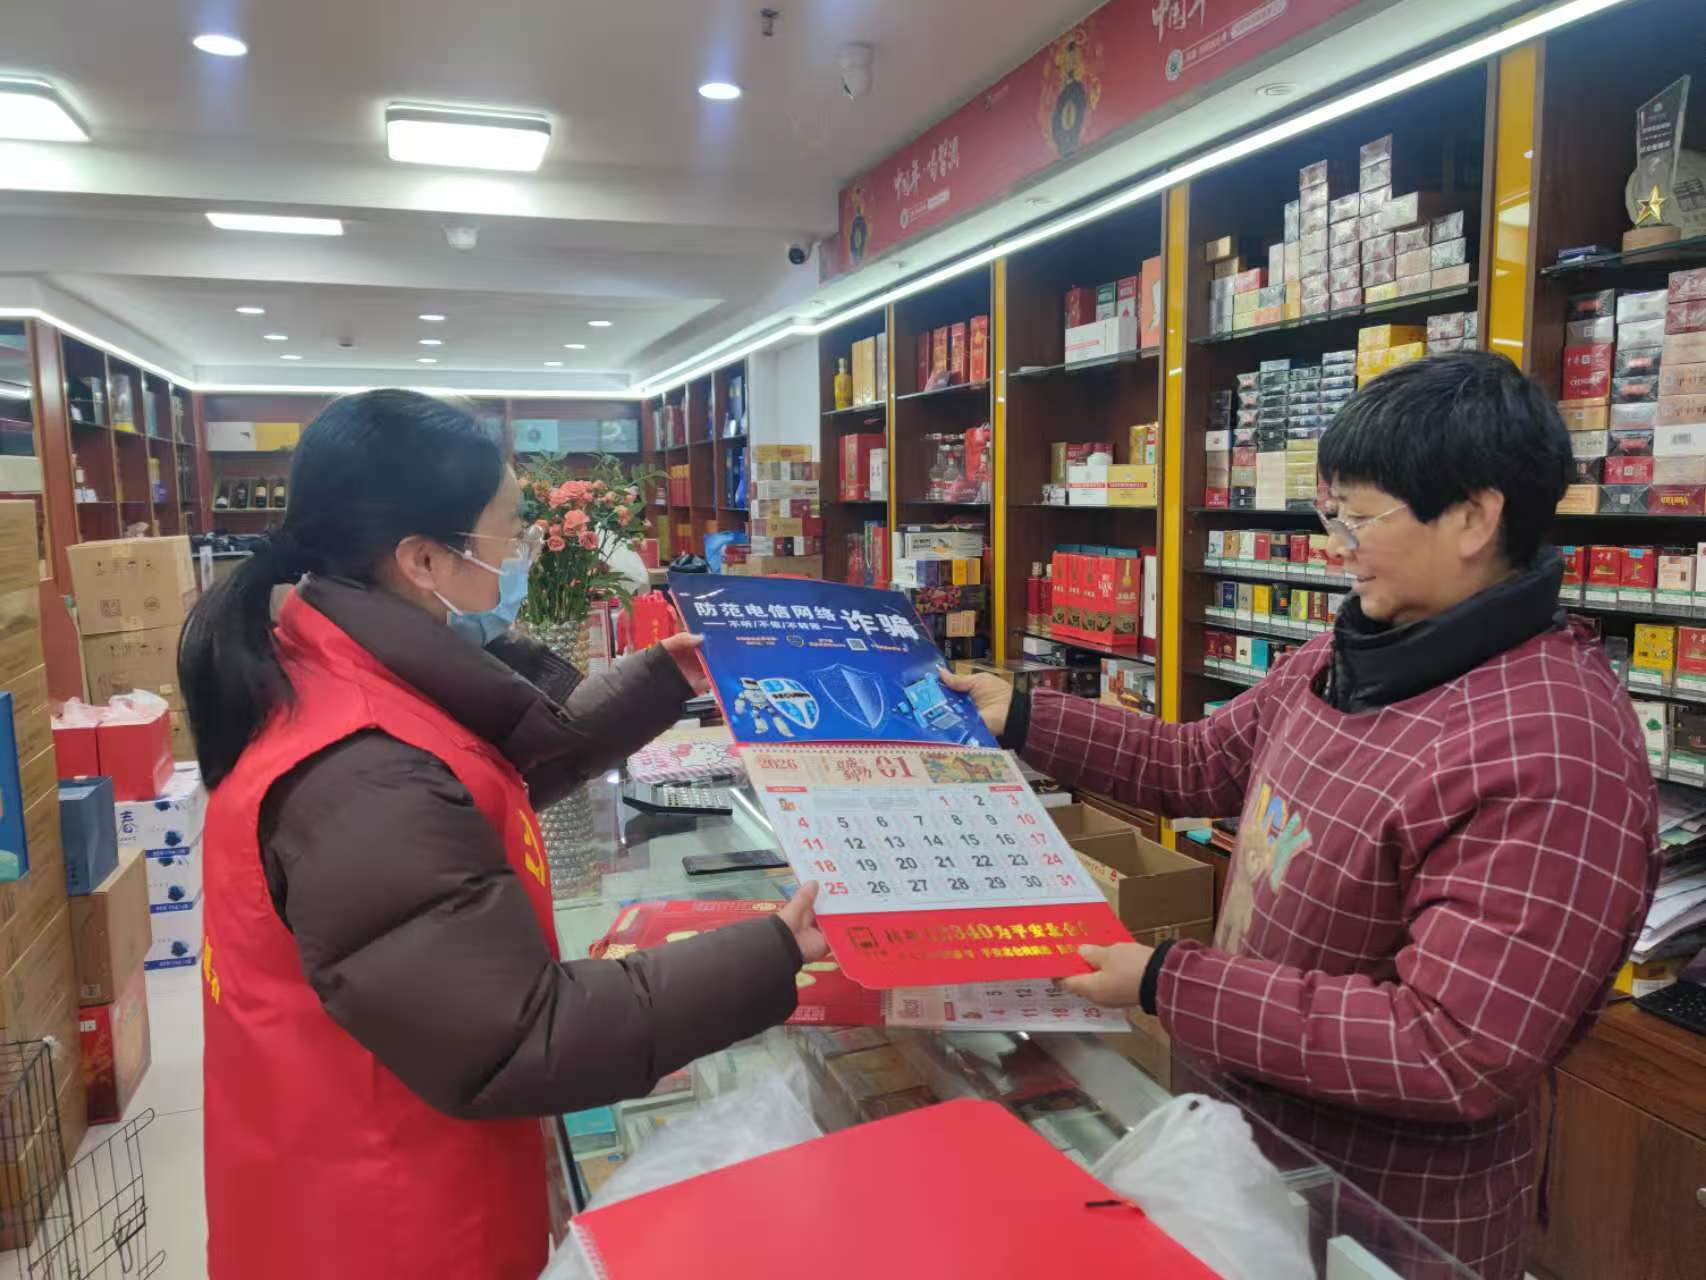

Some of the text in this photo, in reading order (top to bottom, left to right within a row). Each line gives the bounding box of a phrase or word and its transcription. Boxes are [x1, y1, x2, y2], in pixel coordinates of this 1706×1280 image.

[693, 602, 920, 641] 防范电信网络 诈骗
[759, 756, 799, 770] 2026
[875, 754, 914, 779] 01
[939, 795, 950, 807] 1
[973, 794, 985, 806] 2
[1008, 794, 1020, 806] 3
[798, 813, 1036, 829] 4 5 6 7 8 9 10
[802, 832, 1048, 850] 11 12 13 14 15 16 17
[813, 853, 1064, 873] 18 19 20 21 22 23 24
[824, 874, 1077, 895] 25 26 27 28 29 30 31
